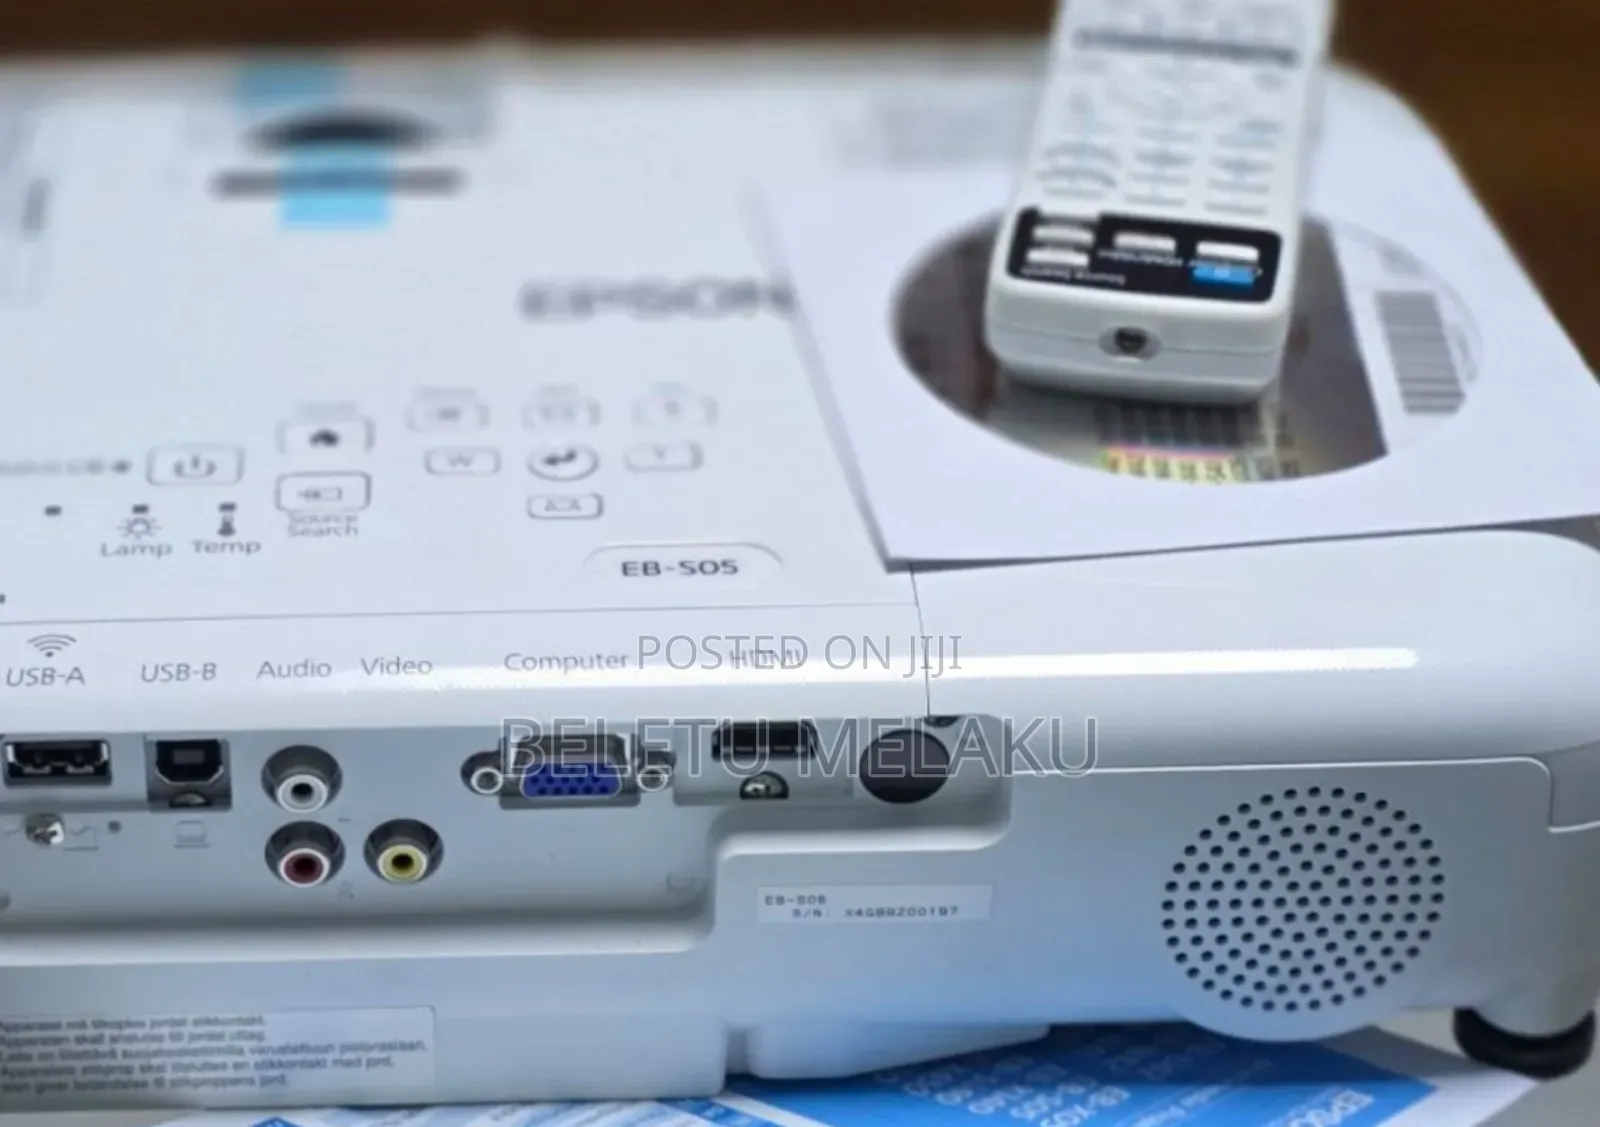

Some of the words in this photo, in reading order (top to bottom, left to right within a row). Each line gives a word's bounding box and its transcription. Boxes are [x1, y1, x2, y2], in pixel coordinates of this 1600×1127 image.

[287, 524, 358, 538] Search
[100, 542, 173, 558] Lamp
[191, 538, 262, 555] Temp
[621, 558, 739, 578] EB-S05
[360, 656, 433, 677] Video
[503, 652, 630, 675] Computer
[729, 647, 801, 670] HDMI
[6, 666, 86, 688] USB-A
[140, 662, 217, 683] USB-B
[256, 659, 332, 680] Audio
